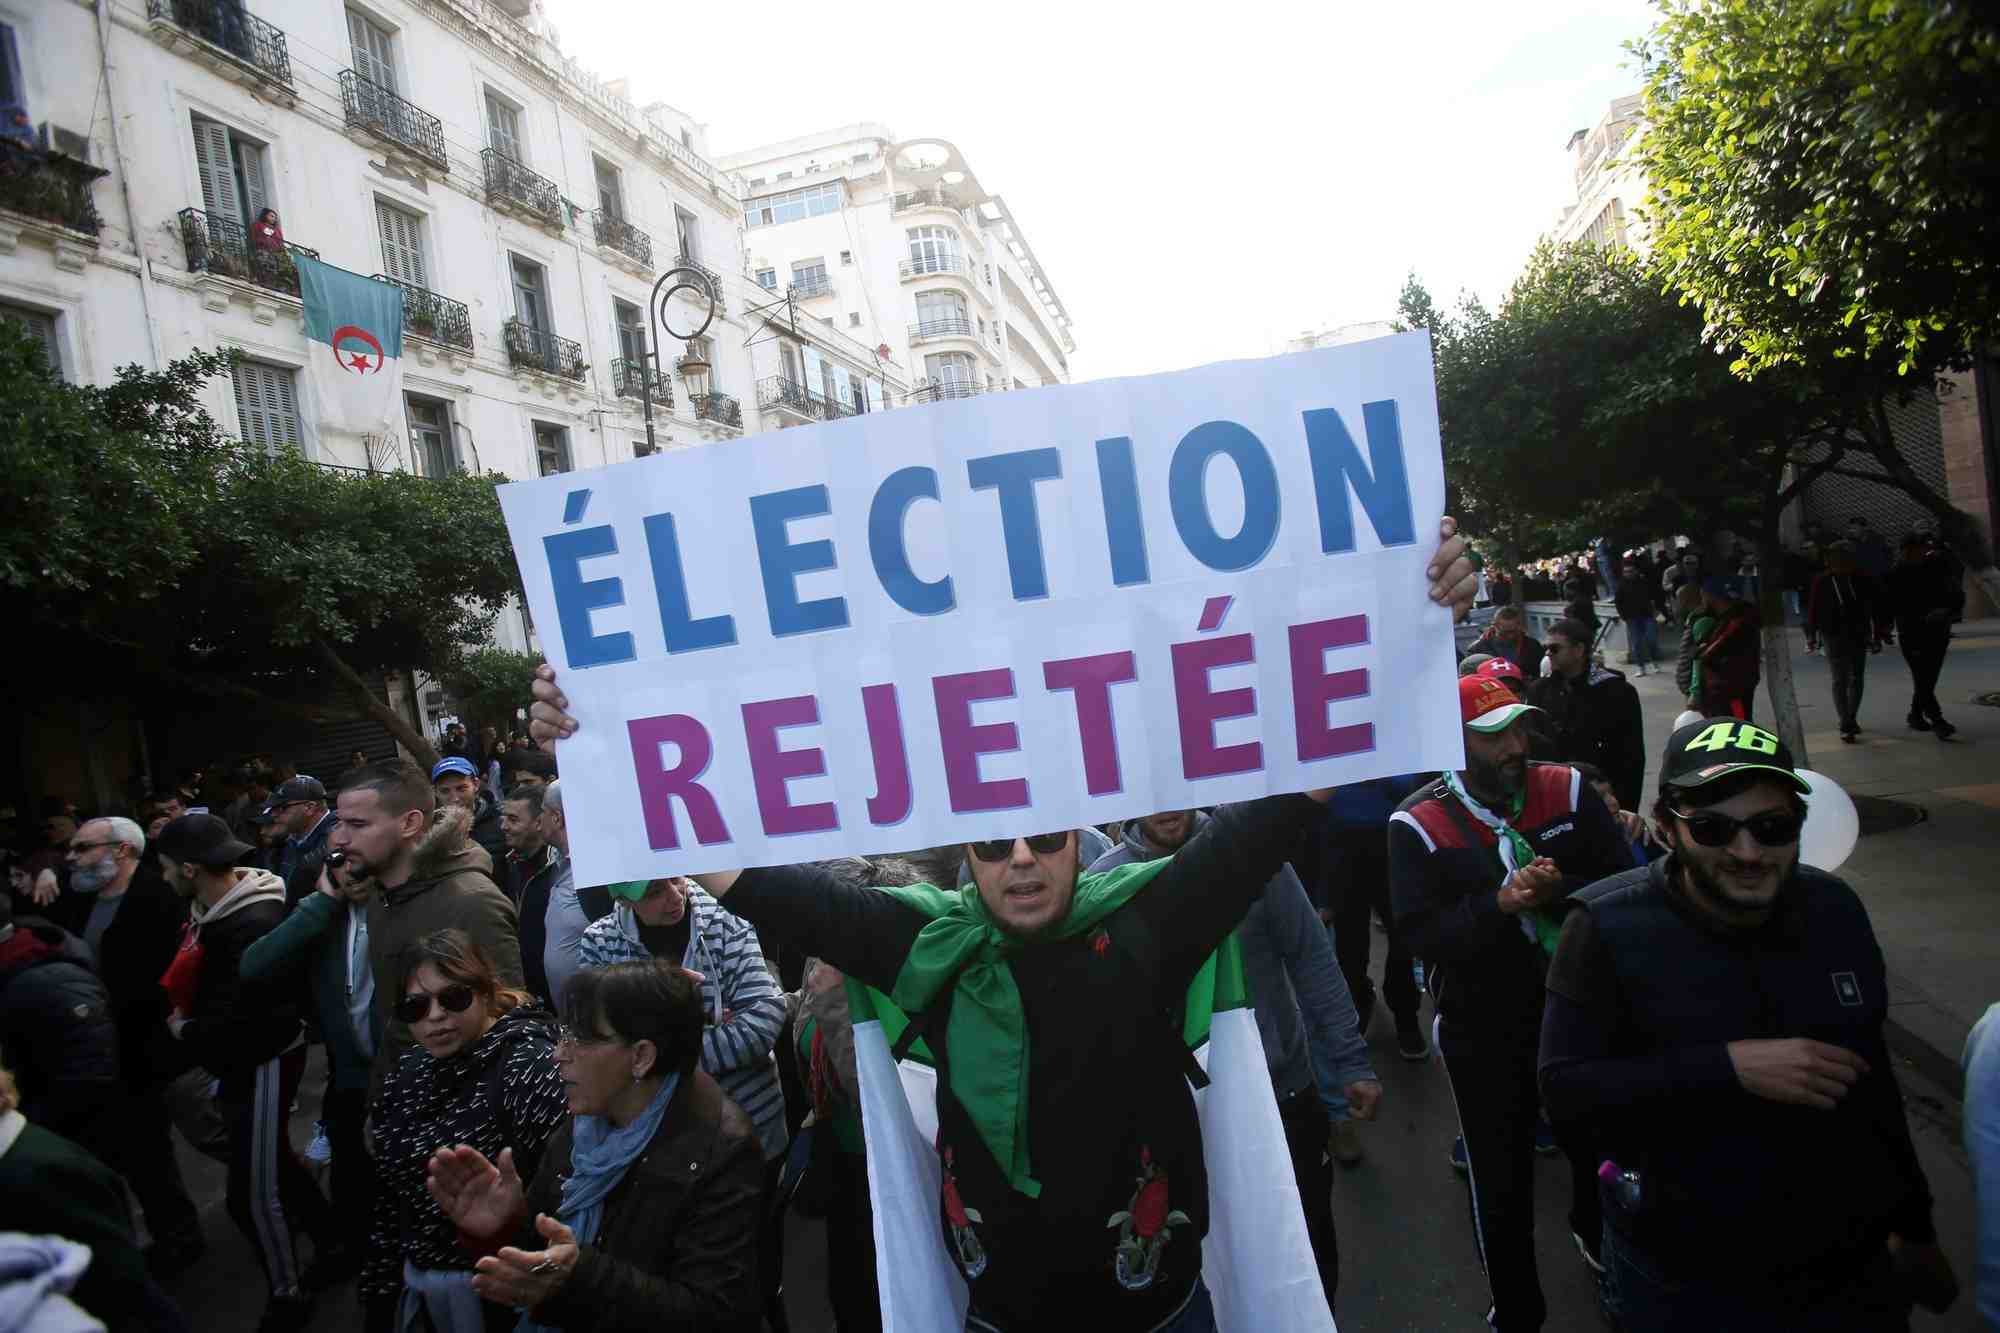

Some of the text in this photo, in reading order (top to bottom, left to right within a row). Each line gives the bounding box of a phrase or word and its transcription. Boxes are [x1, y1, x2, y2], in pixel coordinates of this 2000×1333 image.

[542, 398, 1417, 671] ÉLECTION
[628, 595, 1375, 850] REJETÉE
[1684, 722, 1780, 756] 46
